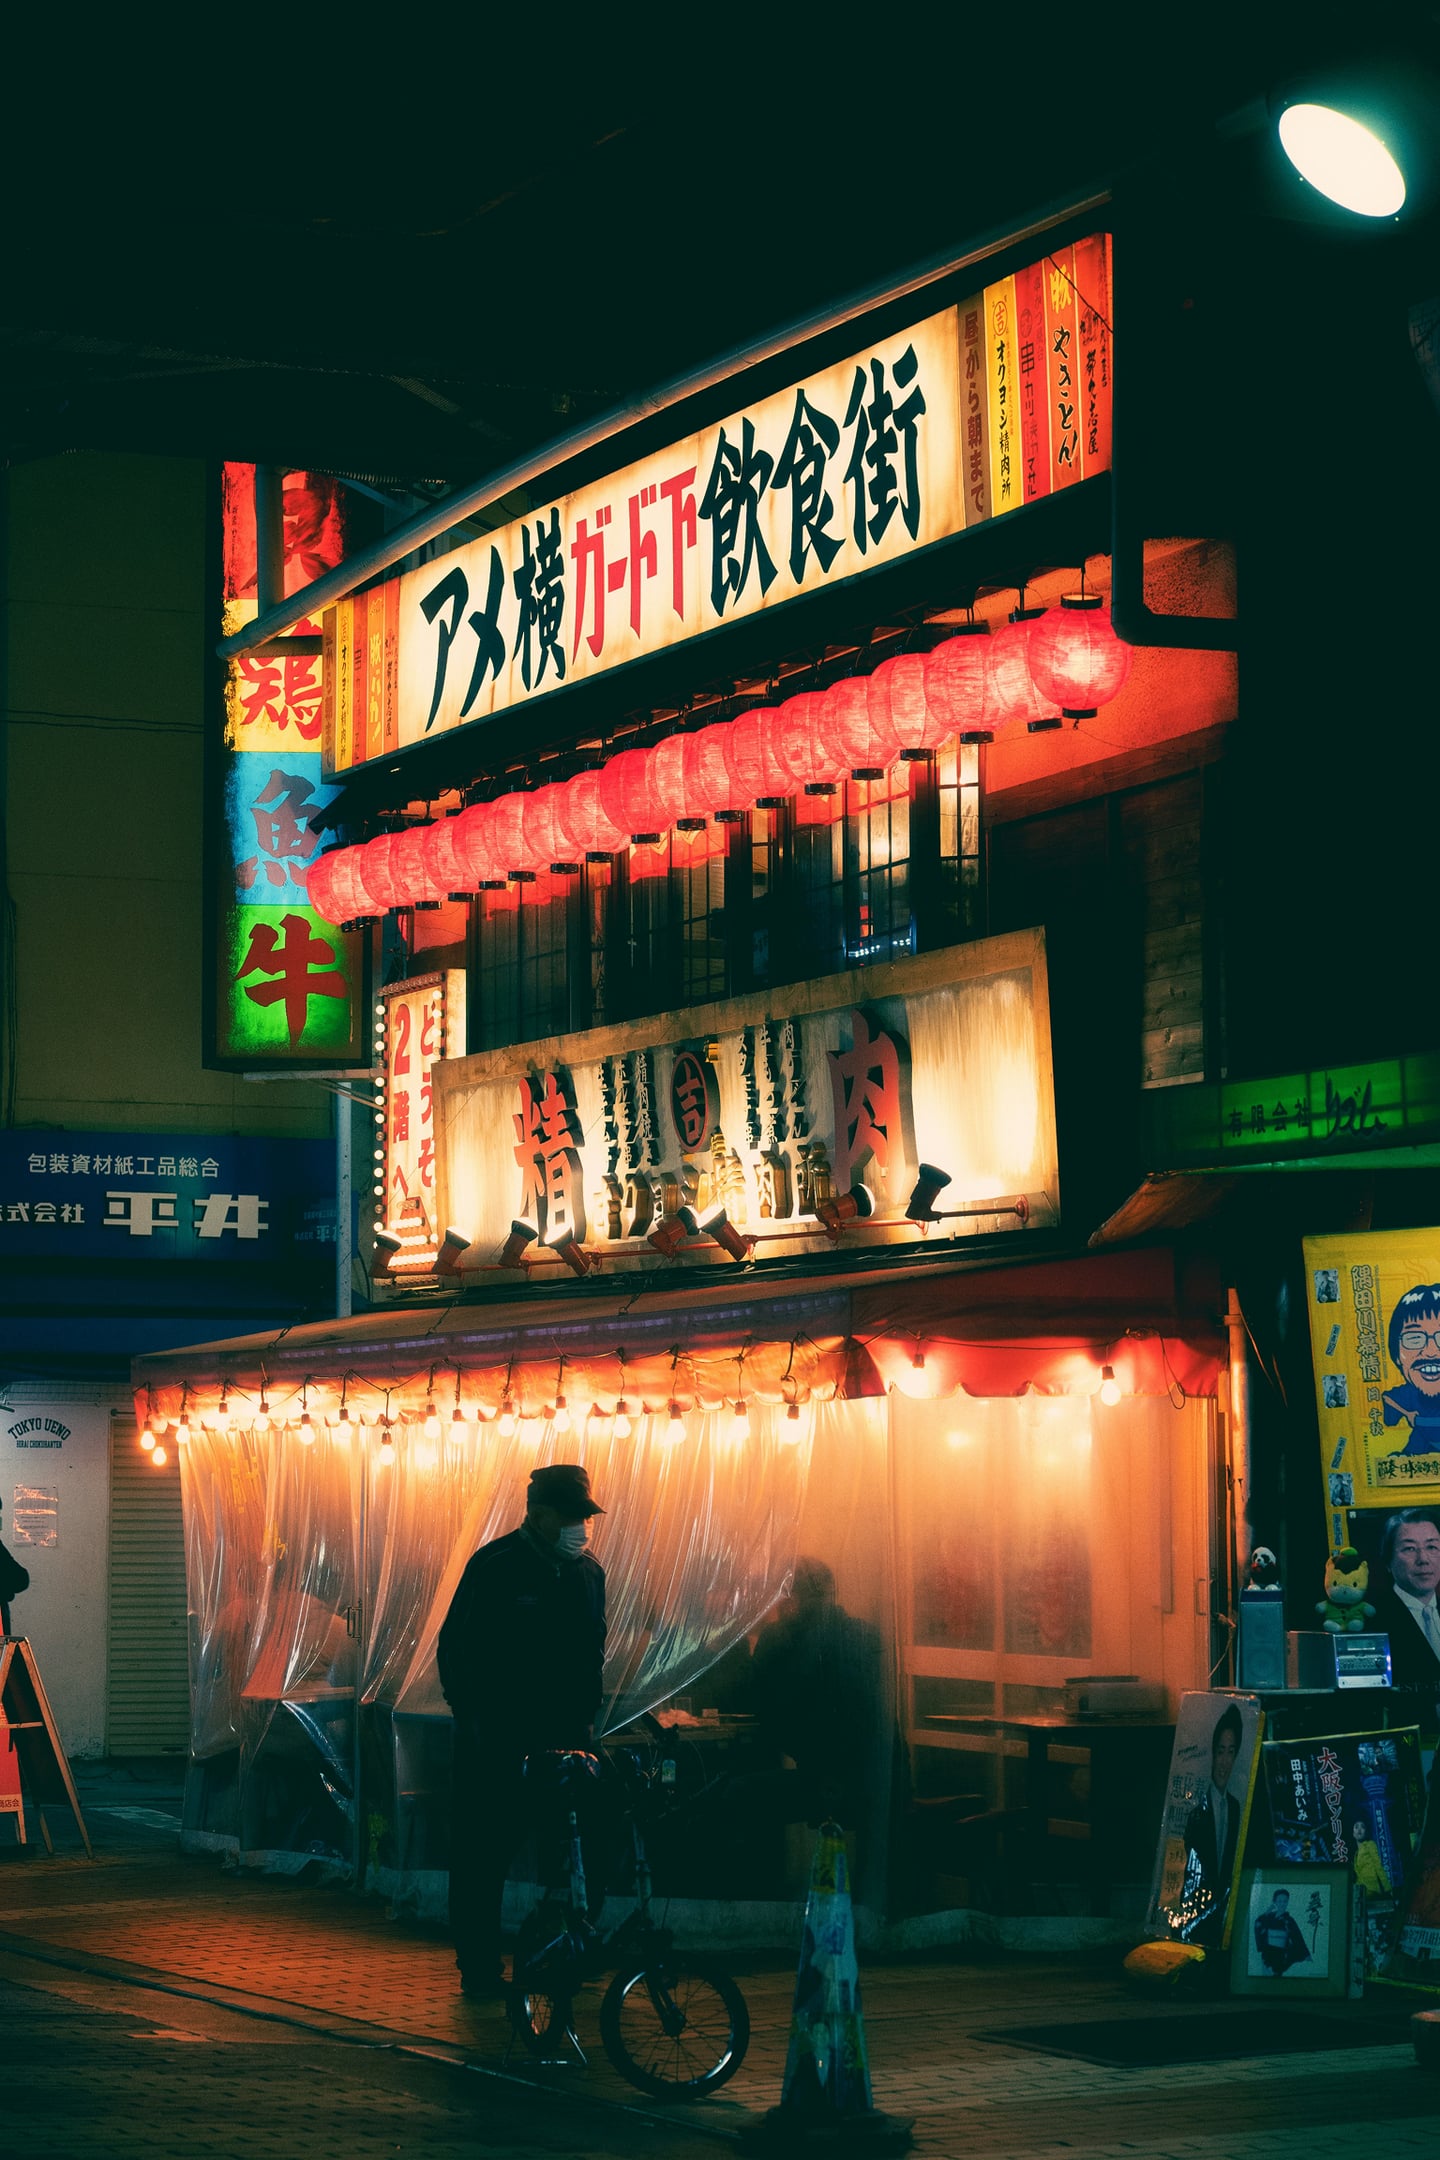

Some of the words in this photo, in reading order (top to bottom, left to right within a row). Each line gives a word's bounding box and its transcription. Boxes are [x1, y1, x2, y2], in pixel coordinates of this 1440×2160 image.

[964, 310, 985, 514] 昼から朝まで
[996, 340, 1012, 501] オクヨシ精肉所
[419, 342, 927, 733] アメ横ガード下飲食街
[235, 769, 326, 890] 魚
[234, 913, 348, 1047] 牛
[392, 1003, 412, 1196] 2階へ
[418, 1000, 437, 1188] どうぞ
[512, 1071, 577, 1240] 精
[673, 1058, 705, 1144] 吉
[826, 1007, 902, 1203] 肉
[1229, 1097, 1310, 1137] 有限会社
[27, 1153, 220, 1178] 包装資材紙工品総合
[103, 1191, 269, 1239] 平井
[8, 1418, 41, 1439] TOKYO
[45, 1418, 71, 1440] UENO
[1290, 1758, 1309, 1822] 田中あいみ
